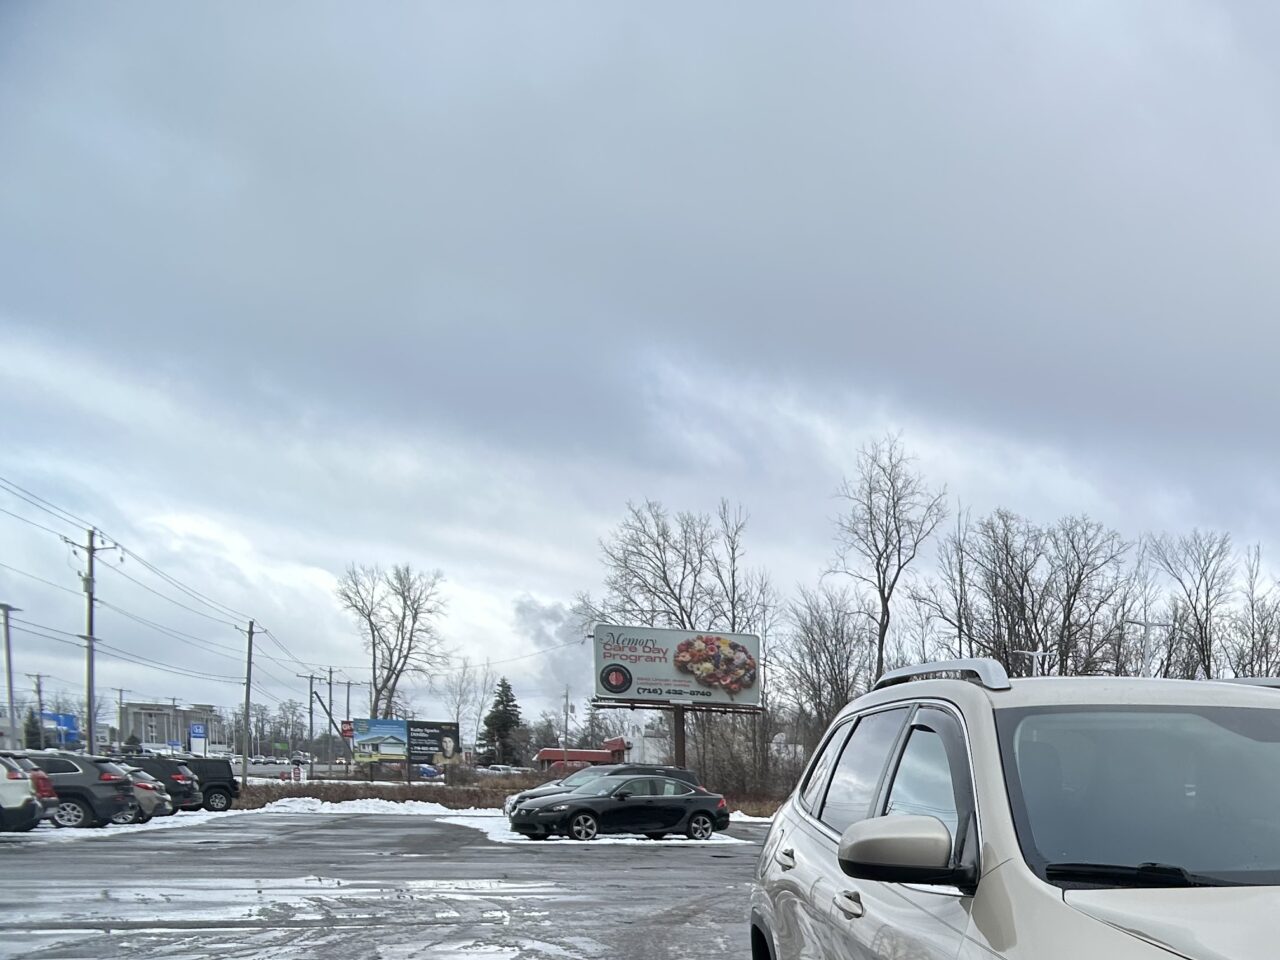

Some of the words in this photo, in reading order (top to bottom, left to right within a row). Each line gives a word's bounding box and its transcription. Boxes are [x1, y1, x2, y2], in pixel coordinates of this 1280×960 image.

[599, 632, 657, 647] Memory
[603, 643, 638, 653] Care
[642, 645, 669, 656] Day
[603, 652, 667, 663] Program
